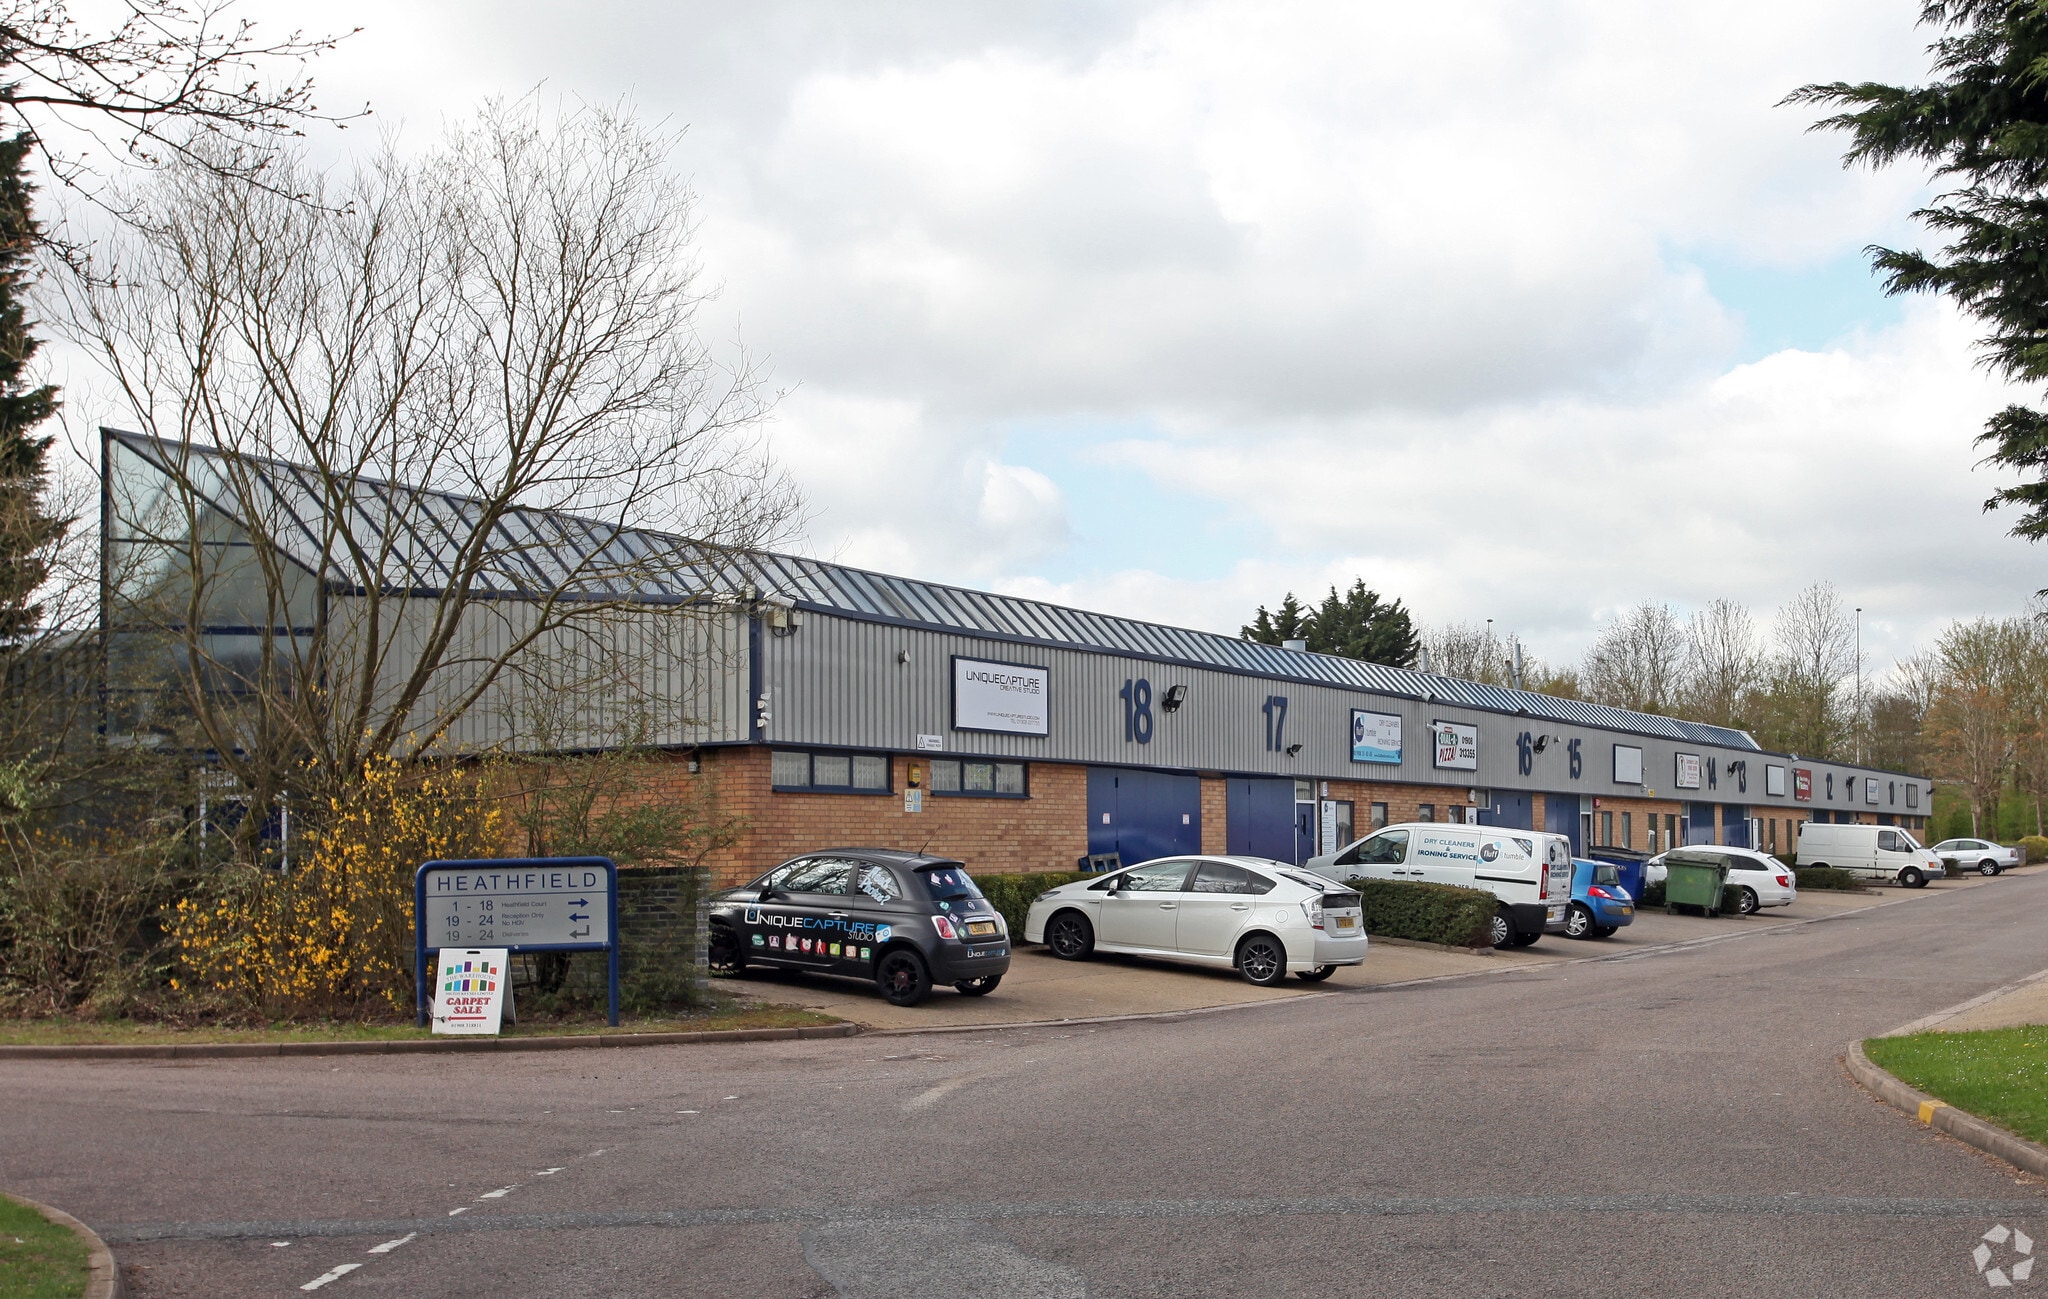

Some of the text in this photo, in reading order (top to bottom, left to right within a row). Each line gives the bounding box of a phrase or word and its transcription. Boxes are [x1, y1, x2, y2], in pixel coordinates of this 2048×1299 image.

[966, 670, 1039, 688] UNIQUECAPTURE
[1000, 684, 1040, 695] CREATIVE STUDIO
[1120, 678, 1153, 745] 18
[1262, 695, 1288, 752] 17
[1439, 745, 1457, 763] PIZZA!
[1516, 731, 1532, 777] 16
[1567, 738, 1582, 780] 15
[1706, 756, 1717, 790] 14
[1737, 760, 1747, 794] 13
[1825, 772, 1833, 801] 12
[1424, 837, 1475, 849] DRY CLEANERS
[1417, 849, 1478, 861] IRONING SERVICE
[1503, 852, 1525, 861] tumble
[437, 872, 597, 892] HEATHFIELD
[452, 901, 458, 912] 1
[480, 899, 494, 911] 18
[445, 915, 460, 927] 19
[479, 914, 494, 926] 24
[445, 930, 460, 942] 19
[479, 929, 494, 941] 24
[848, 931, 874, 941] STUDIO
[446, 997, 491, 1006] CARPET
[453, 1006, 483, 1014] SALE
